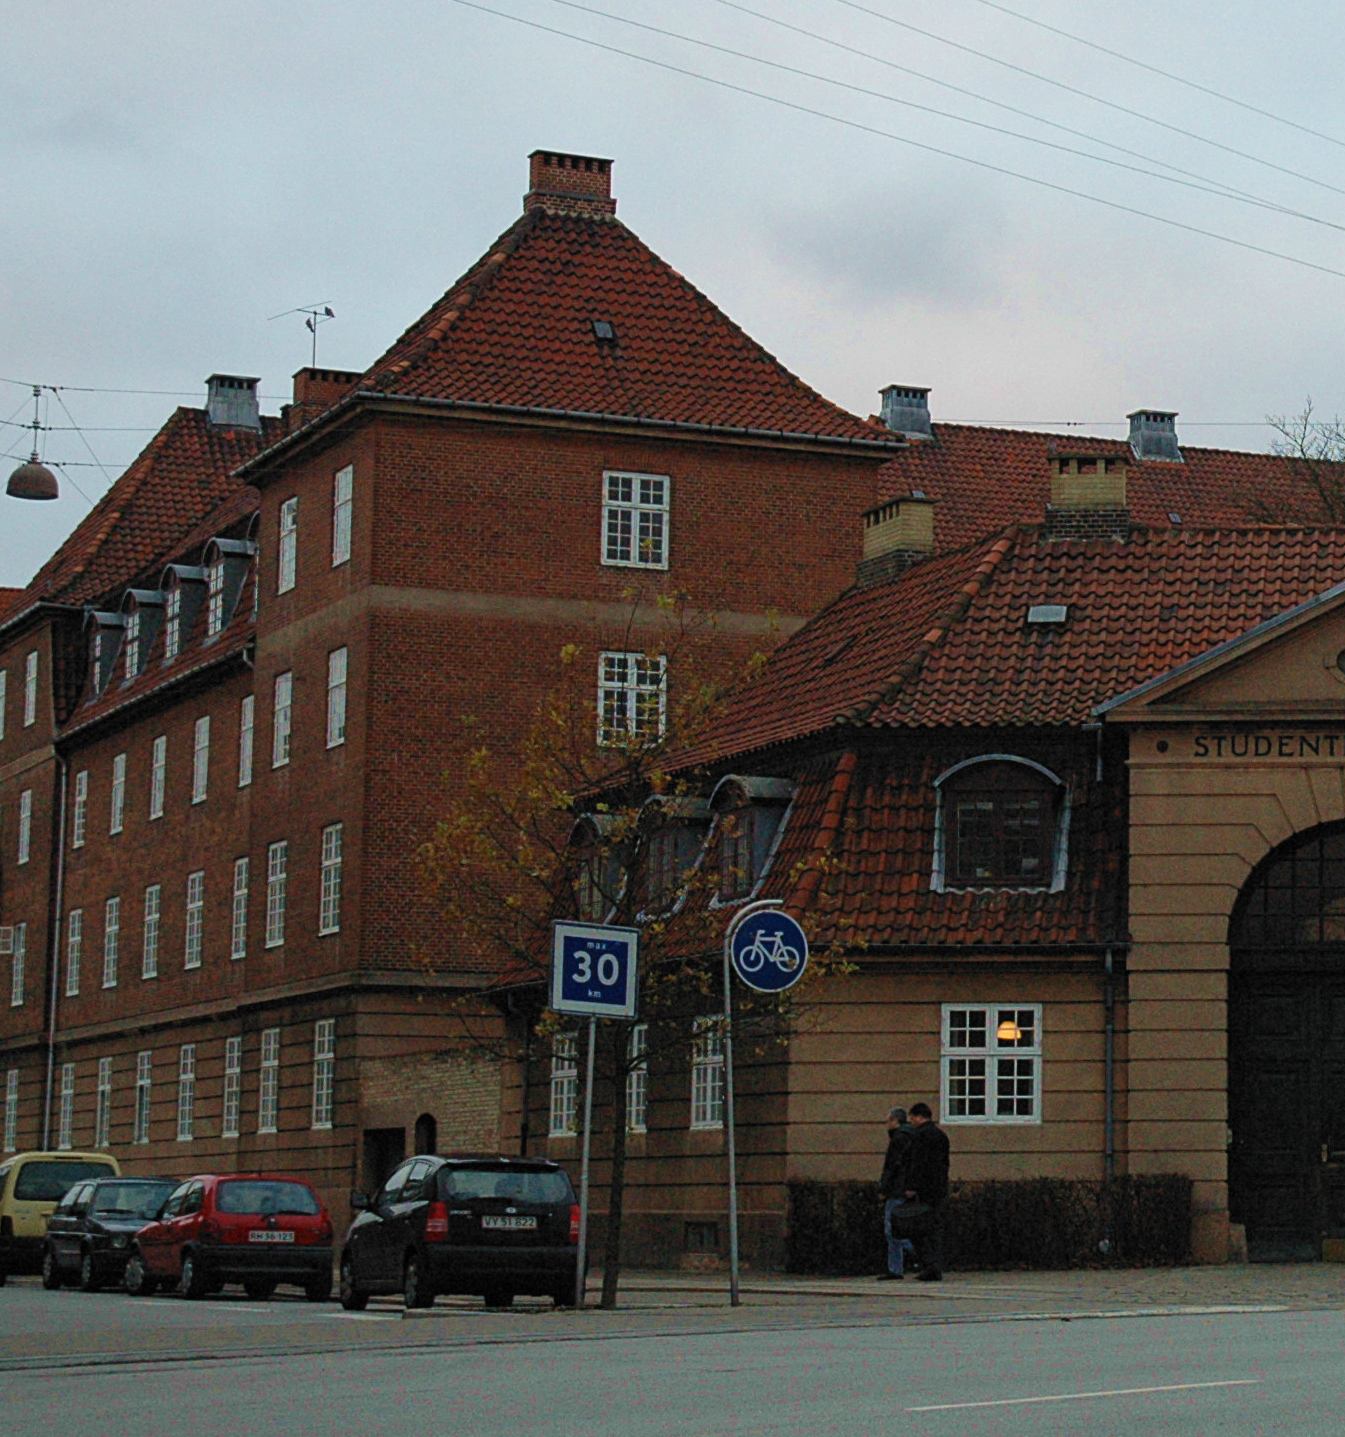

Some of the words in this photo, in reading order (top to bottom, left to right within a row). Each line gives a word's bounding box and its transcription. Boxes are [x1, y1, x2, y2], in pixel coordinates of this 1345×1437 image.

[587, 942, 606, 950] max
[572, 951, 618, 985] 30
[588, 988, 601, 998] km
